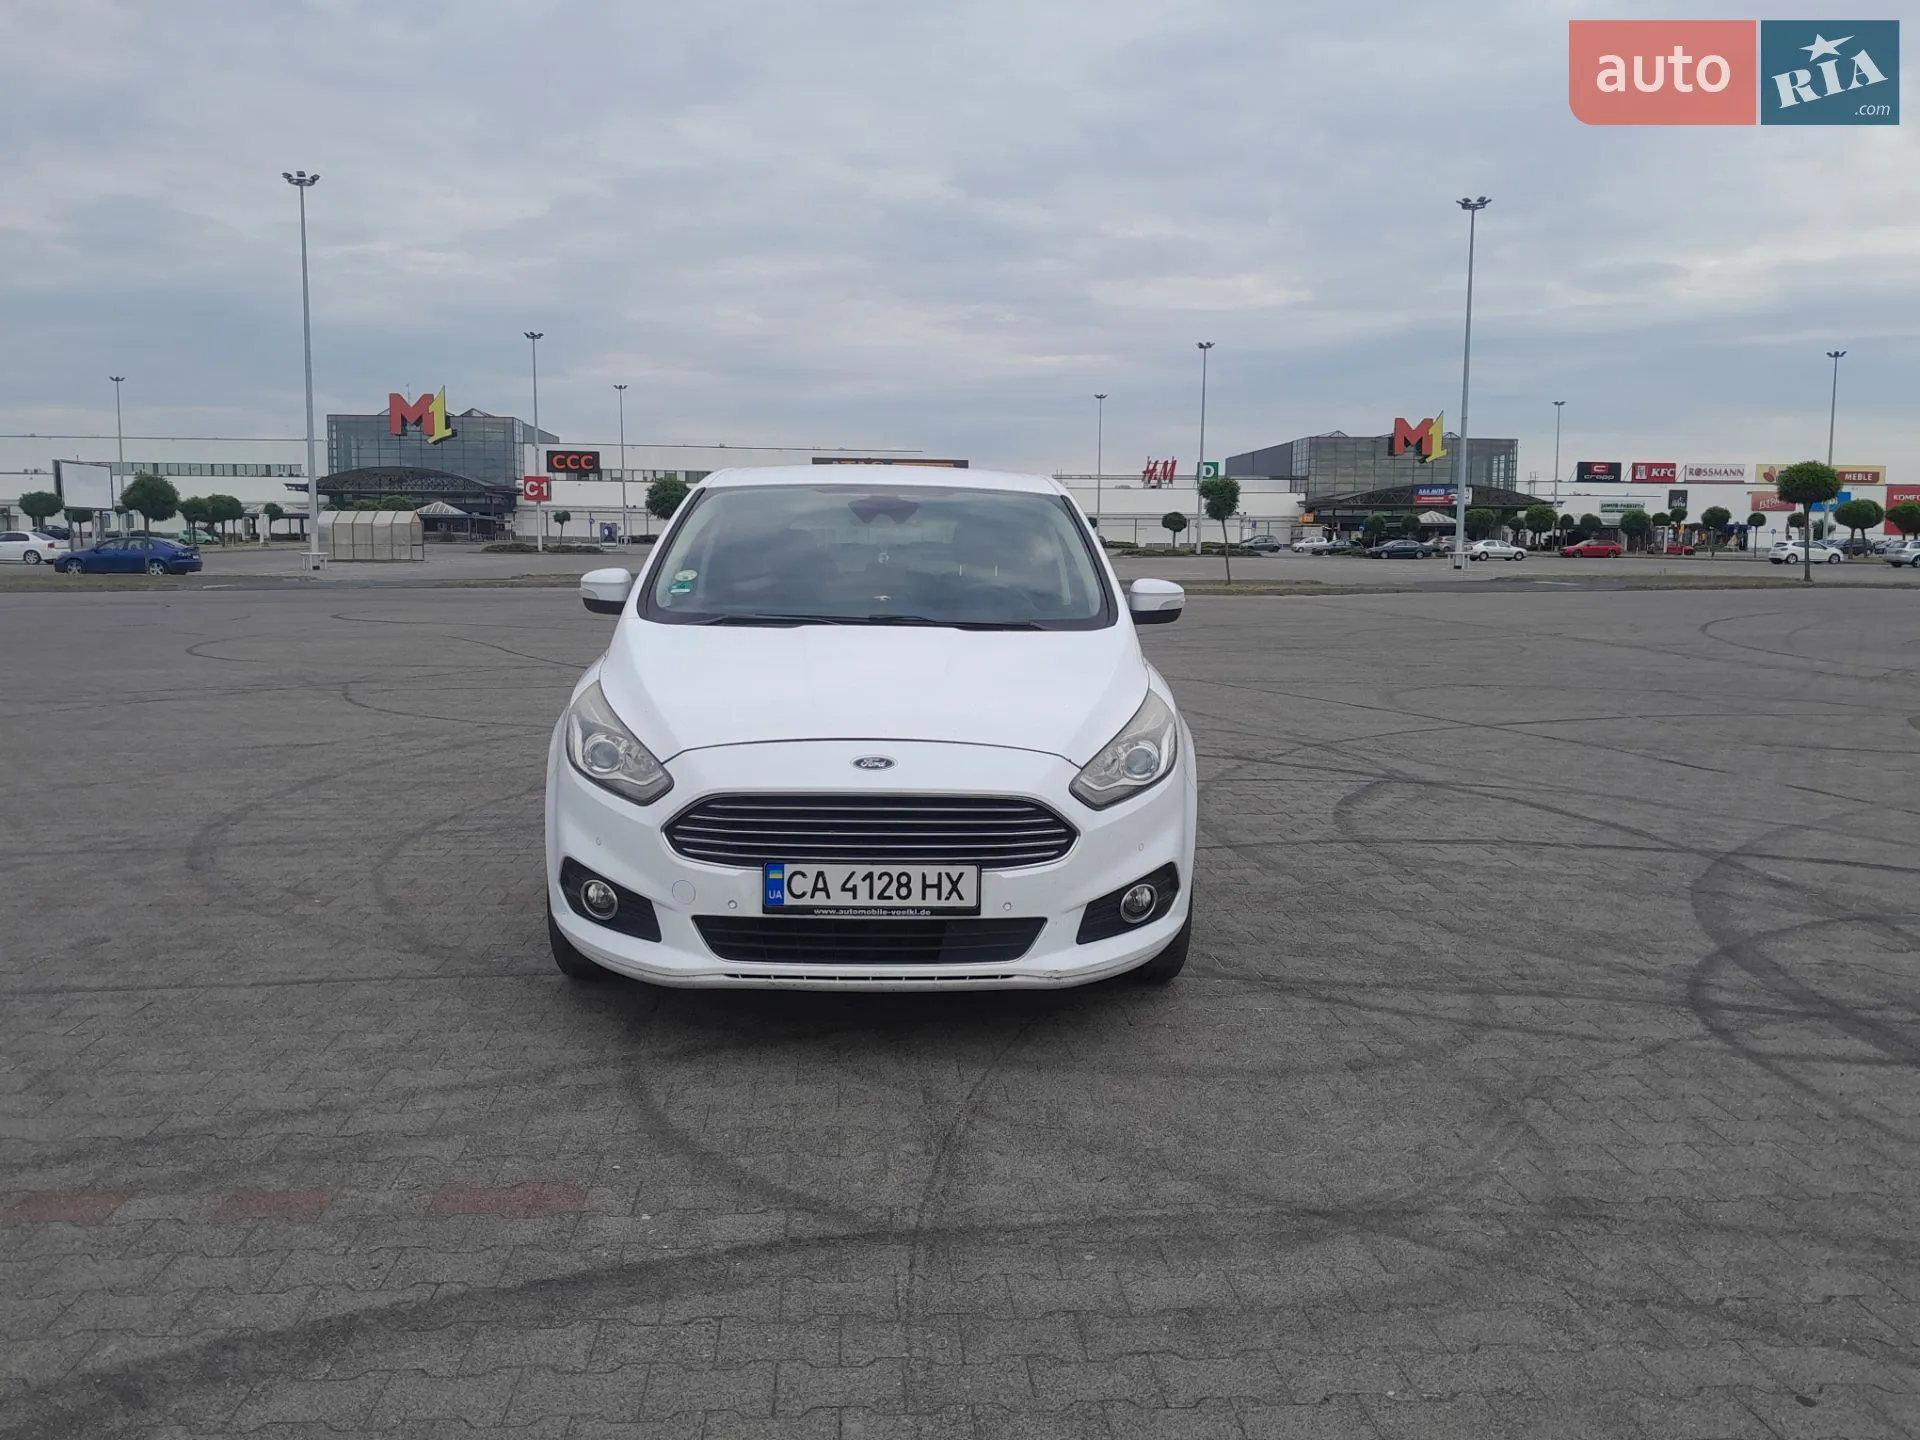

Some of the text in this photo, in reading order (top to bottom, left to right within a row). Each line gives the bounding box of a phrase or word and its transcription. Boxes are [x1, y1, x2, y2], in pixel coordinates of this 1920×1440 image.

[389, 385, 452, 444] M1
[1394, 409, 1447, 462] M1
[552, 454, 593, 469] CCC
[1202, 465, 1215, 478] D
[1650, 468, 1675, 477] KFC
[1688, 467, 1745, 477] ROSSMANN
[1844, 473, 1873, 481] MEBLE
[525, 481, 548, 496] C1
[786, 870, 965, 900] CA 4128 HX
[768, 889, 782, 899] UA
